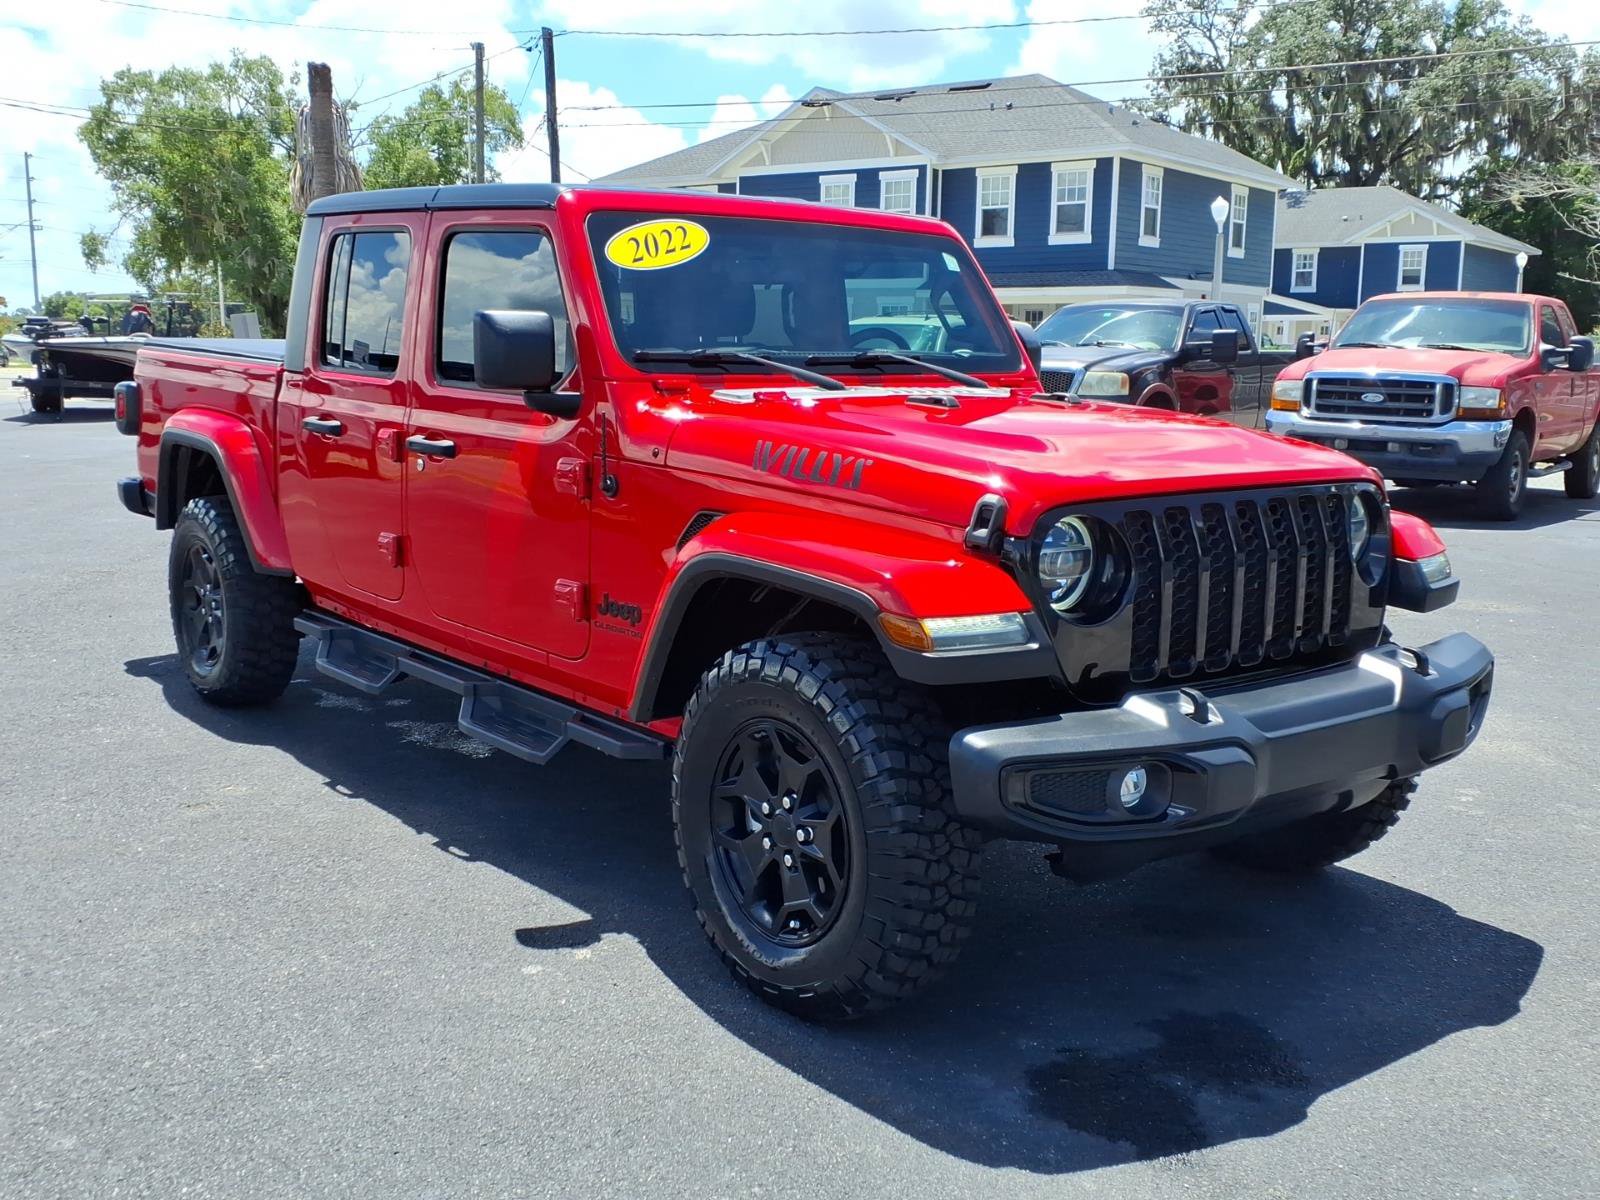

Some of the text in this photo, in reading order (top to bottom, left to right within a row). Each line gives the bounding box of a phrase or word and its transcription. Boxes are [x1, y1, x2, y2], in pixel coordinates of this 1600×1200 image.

[627, 225, 691, 263] 2022
[753, 439, 873, 489] WILLYS
[597, 592, 642, 626] Jeep
